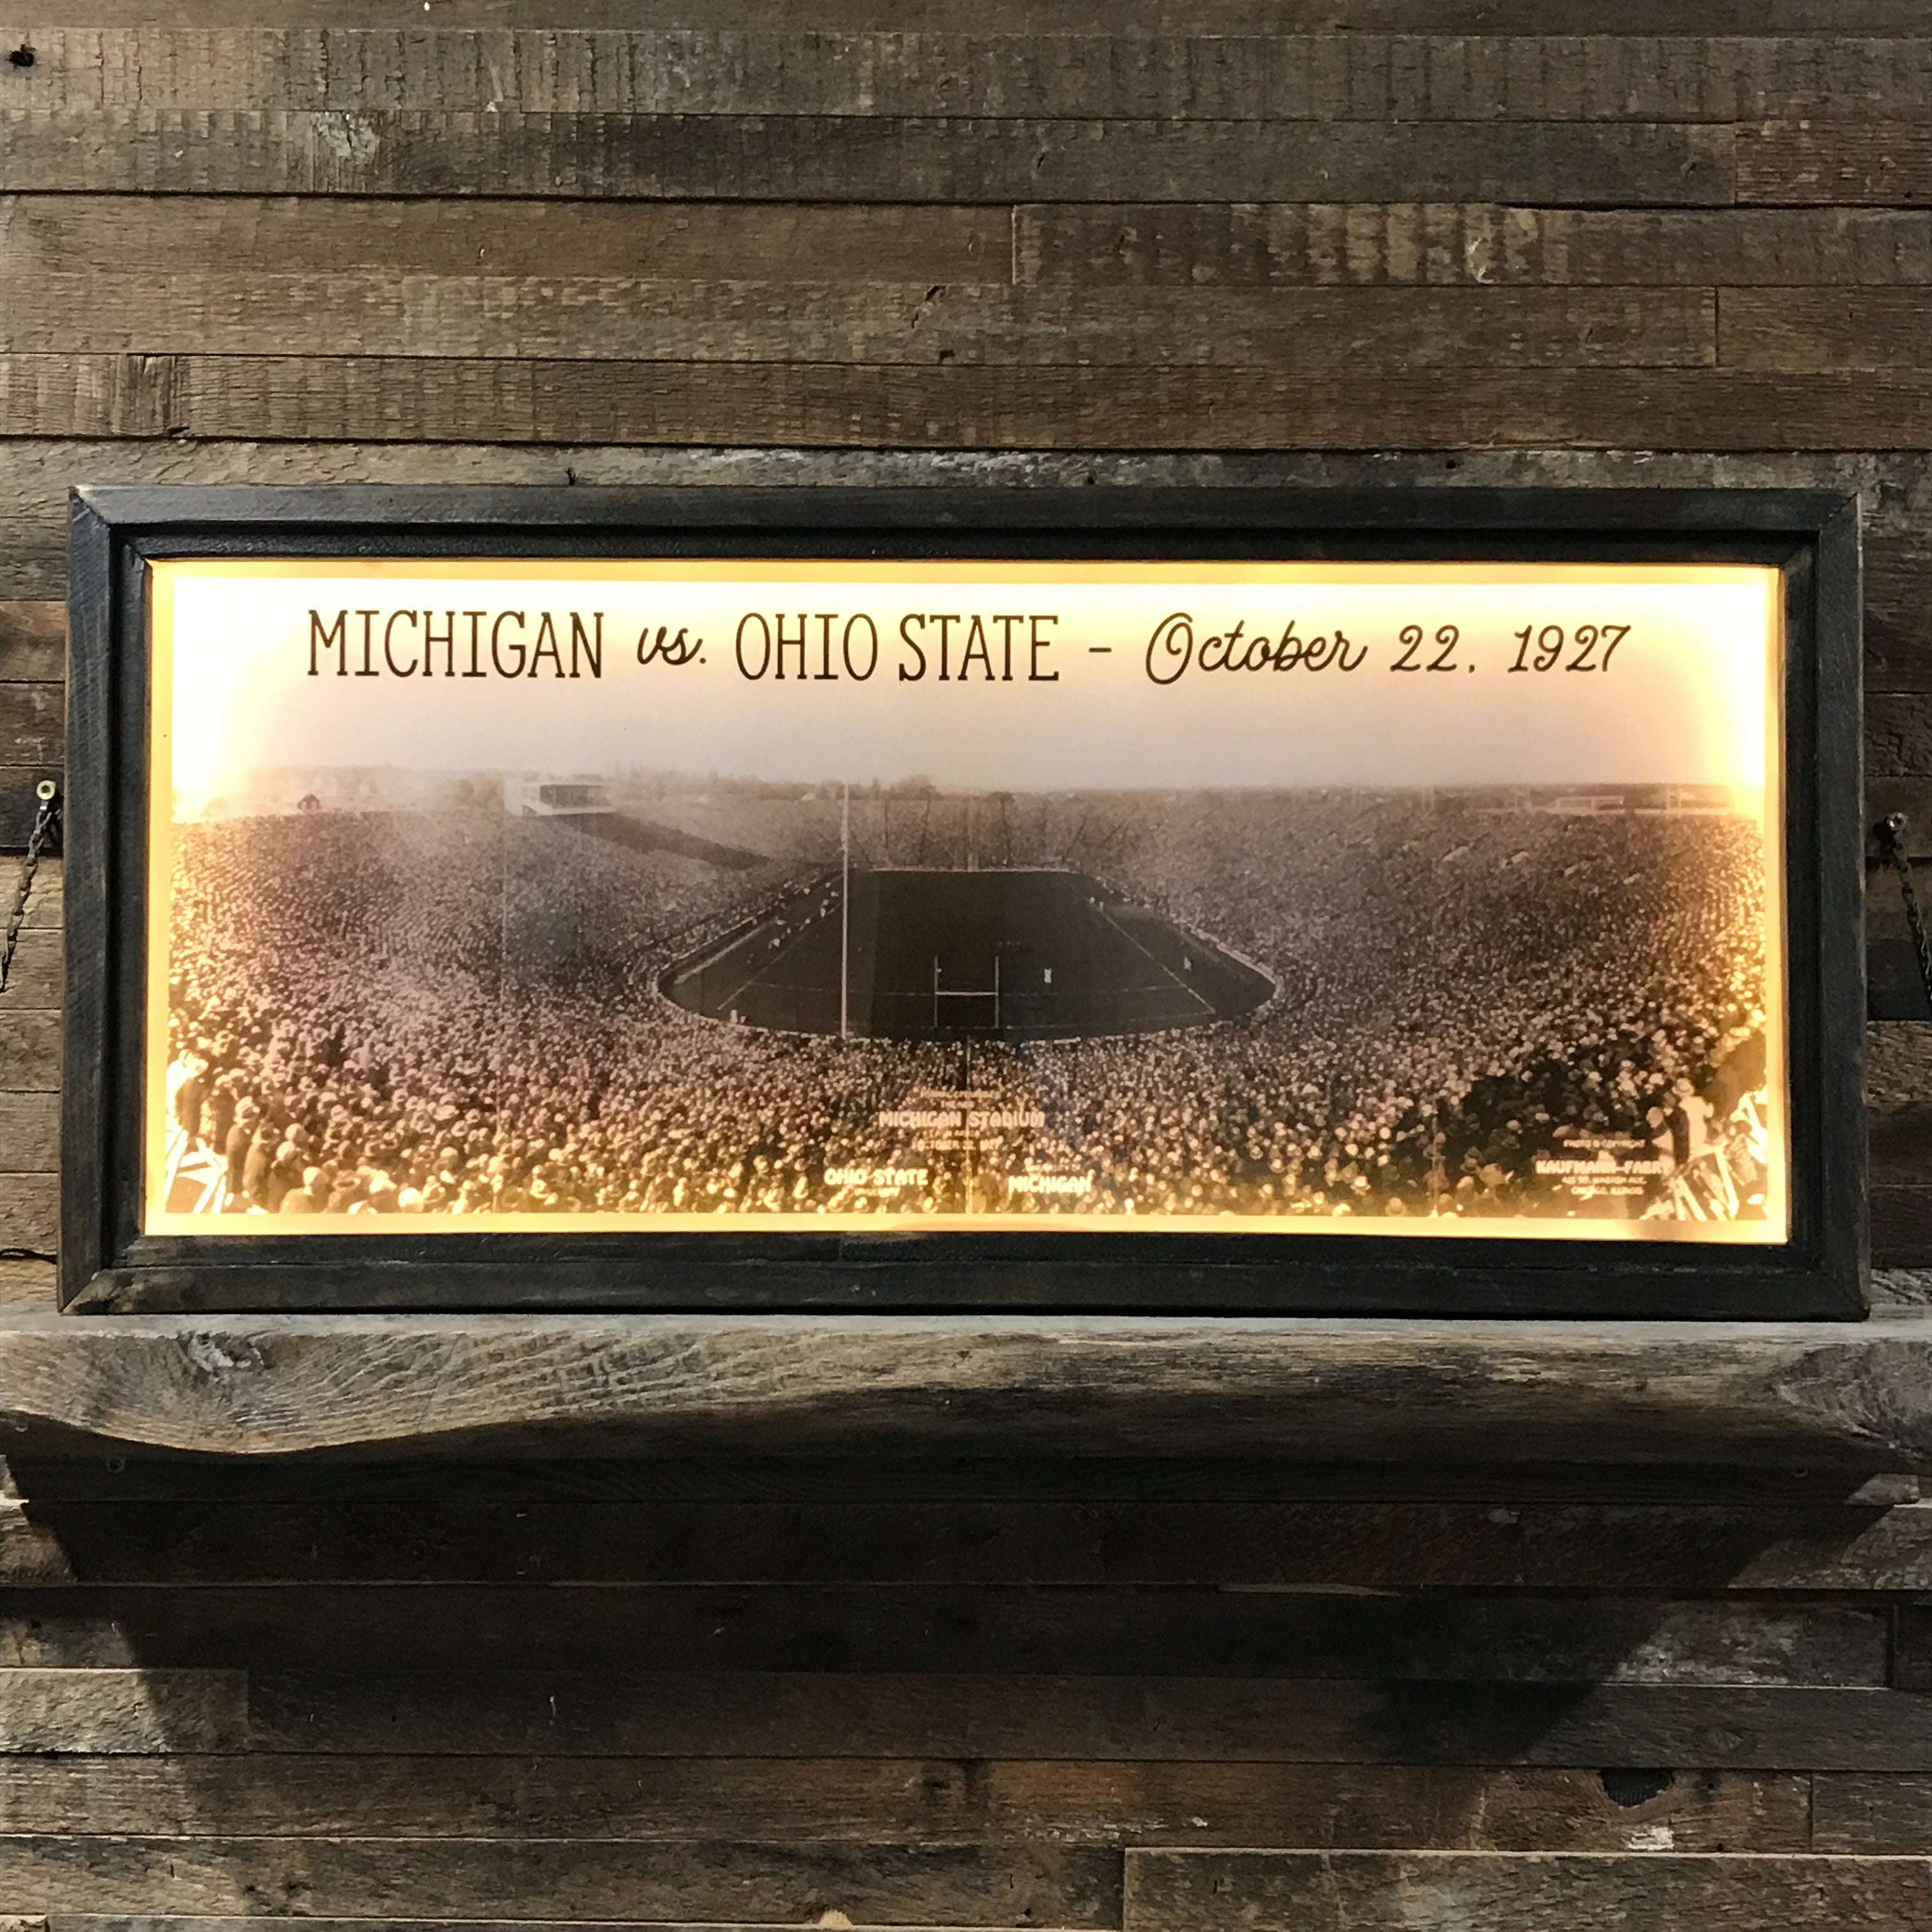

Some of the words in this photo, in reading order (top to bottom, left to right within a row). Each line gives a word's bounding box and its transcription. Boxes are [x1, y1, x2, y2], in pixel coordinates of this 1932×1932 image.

[307, 610, 604, 678] MICHIGAN
[636, 626, 707, 666] vs.
[735, 612, 878, 682] OHIO
[898, 613, 1059, 682] STATE
[1145, 612, 1368, 686] October
[1507, 624, 1632, 673] 1927
[878, 1110, 962, 1128] MICHIGAN
[968, 1110, 1046, 1128] STADIUM
[824, 1167, 868, 1186] OHIO
[872, 1167, 928, 1186] STATE
[1009, 1175, 1092, 1193] MICHIGAN
